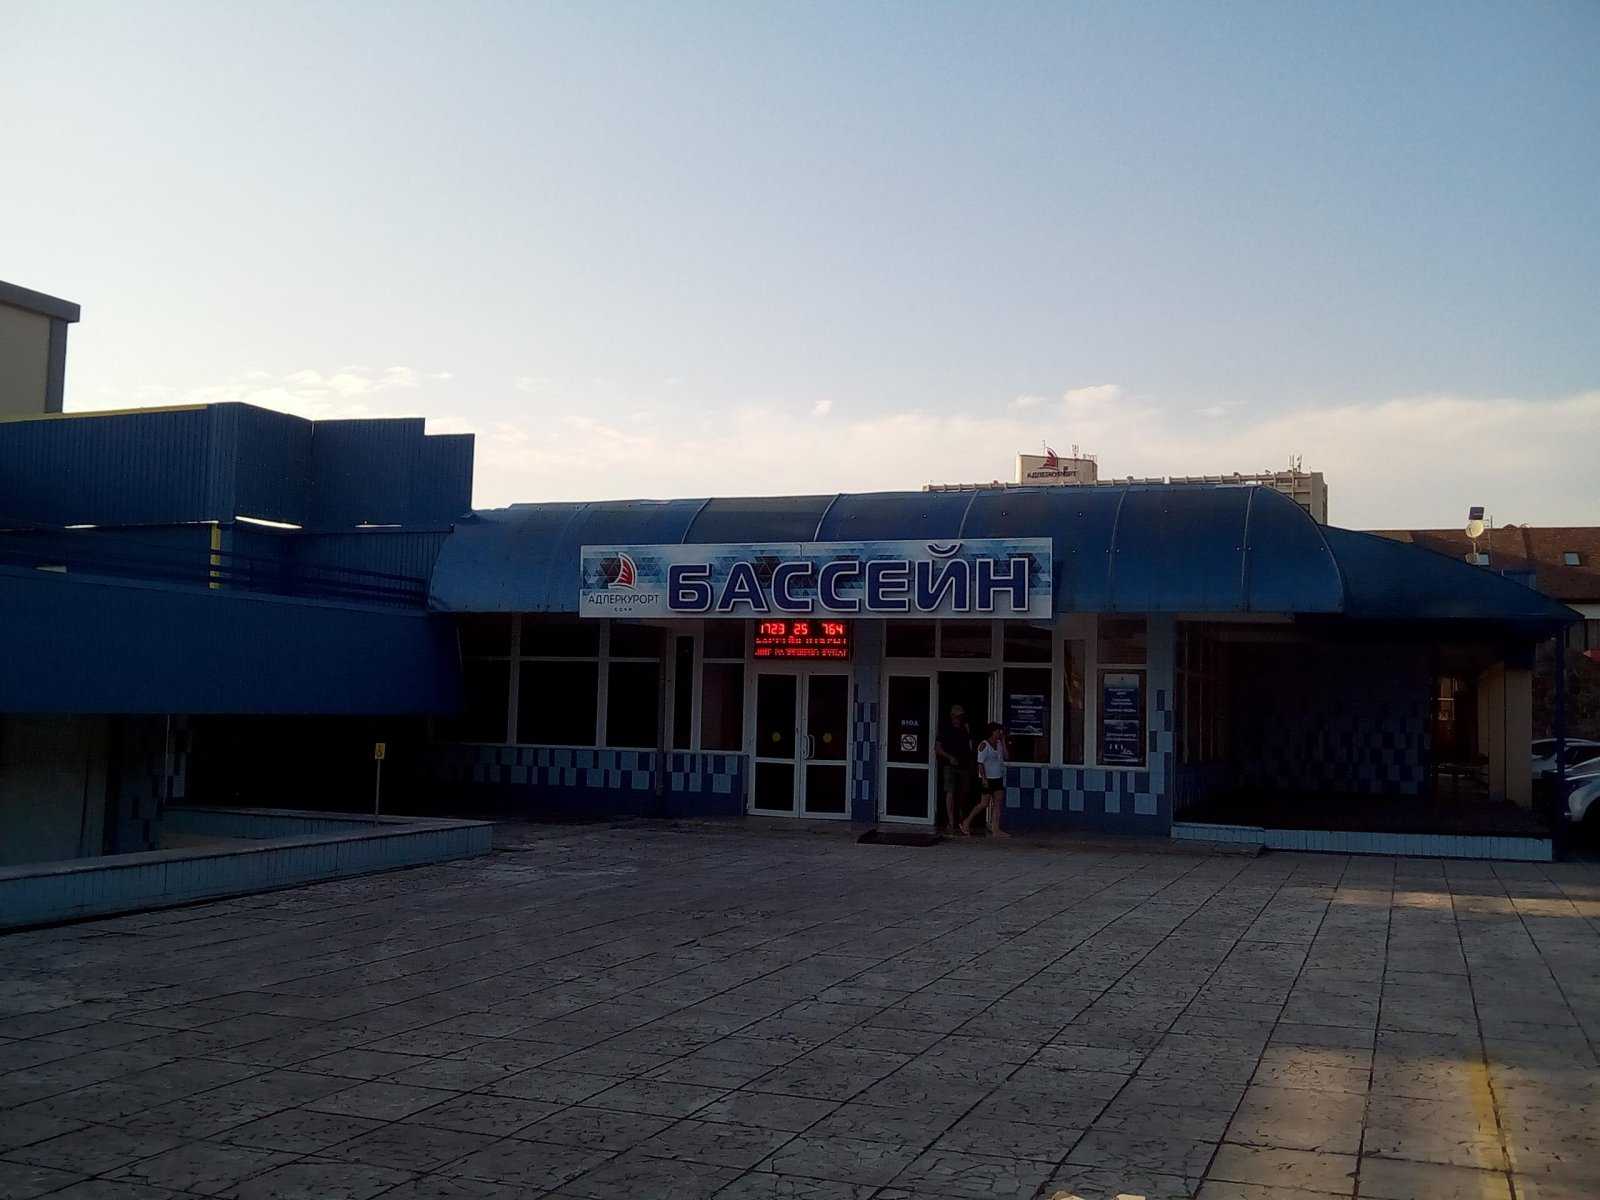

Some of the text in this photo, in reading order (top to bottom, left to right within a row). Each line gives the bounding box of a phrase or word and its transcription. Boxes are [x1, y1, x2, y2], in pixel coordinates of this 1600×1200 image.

[667, 542, 1031, 613] БАССЕЙН
[588, 594, 659, 605] АДЛЕРКУРОРТ
[794, 623, 808, 635] 25
[822, 623, 843, 635] 764
